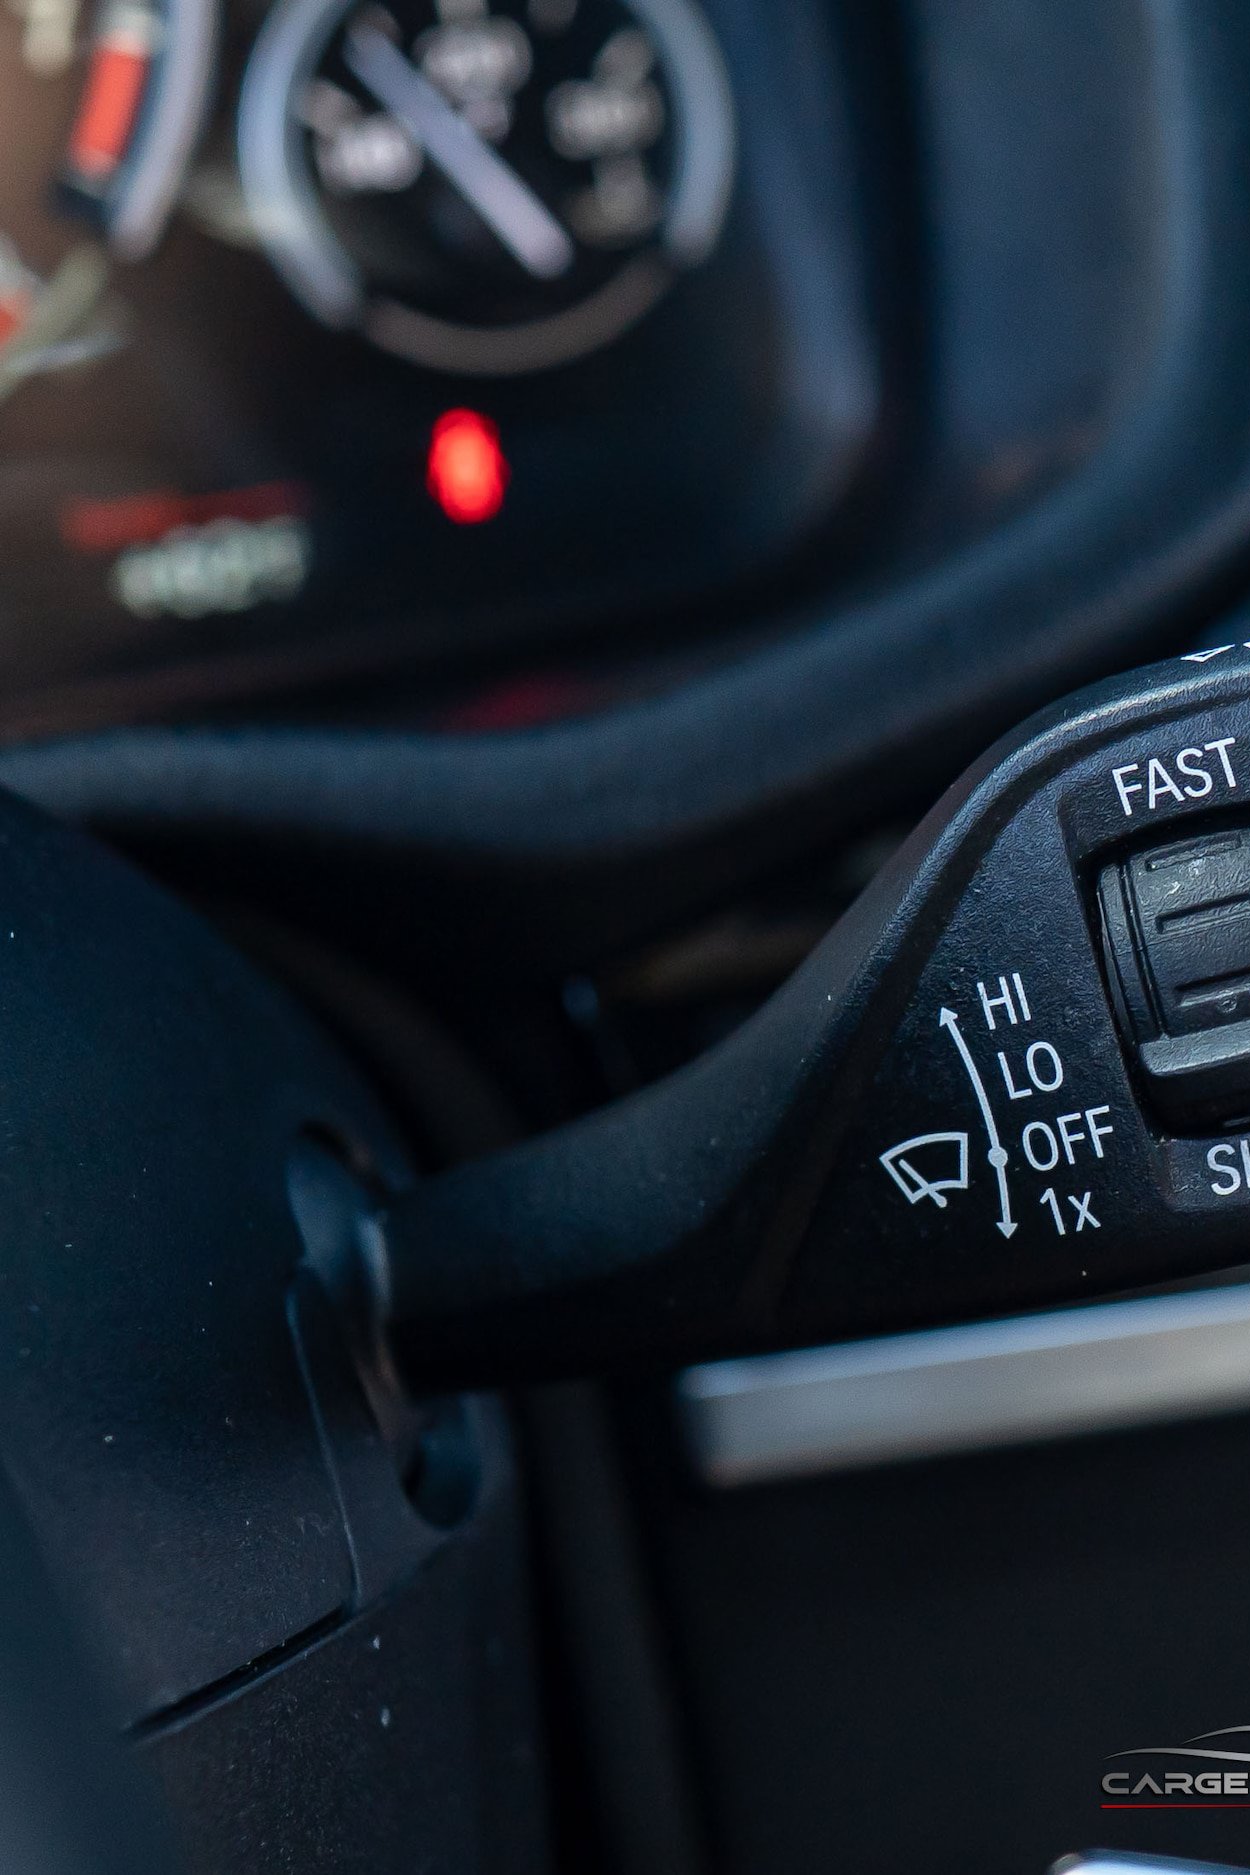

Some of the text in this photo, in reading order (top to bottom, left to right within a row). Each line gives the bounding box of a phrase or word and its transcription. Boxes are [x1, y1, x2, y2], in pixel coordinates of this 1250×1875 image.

[1112, 737, 1239, 815] FAST
[977, 973, 1031, 1030] HI
[997, 1041, 1063, 1099] LO
[1022, 1105, 1113, 1171] OFF
[1039, 1187, 1101, 1236] 1x
